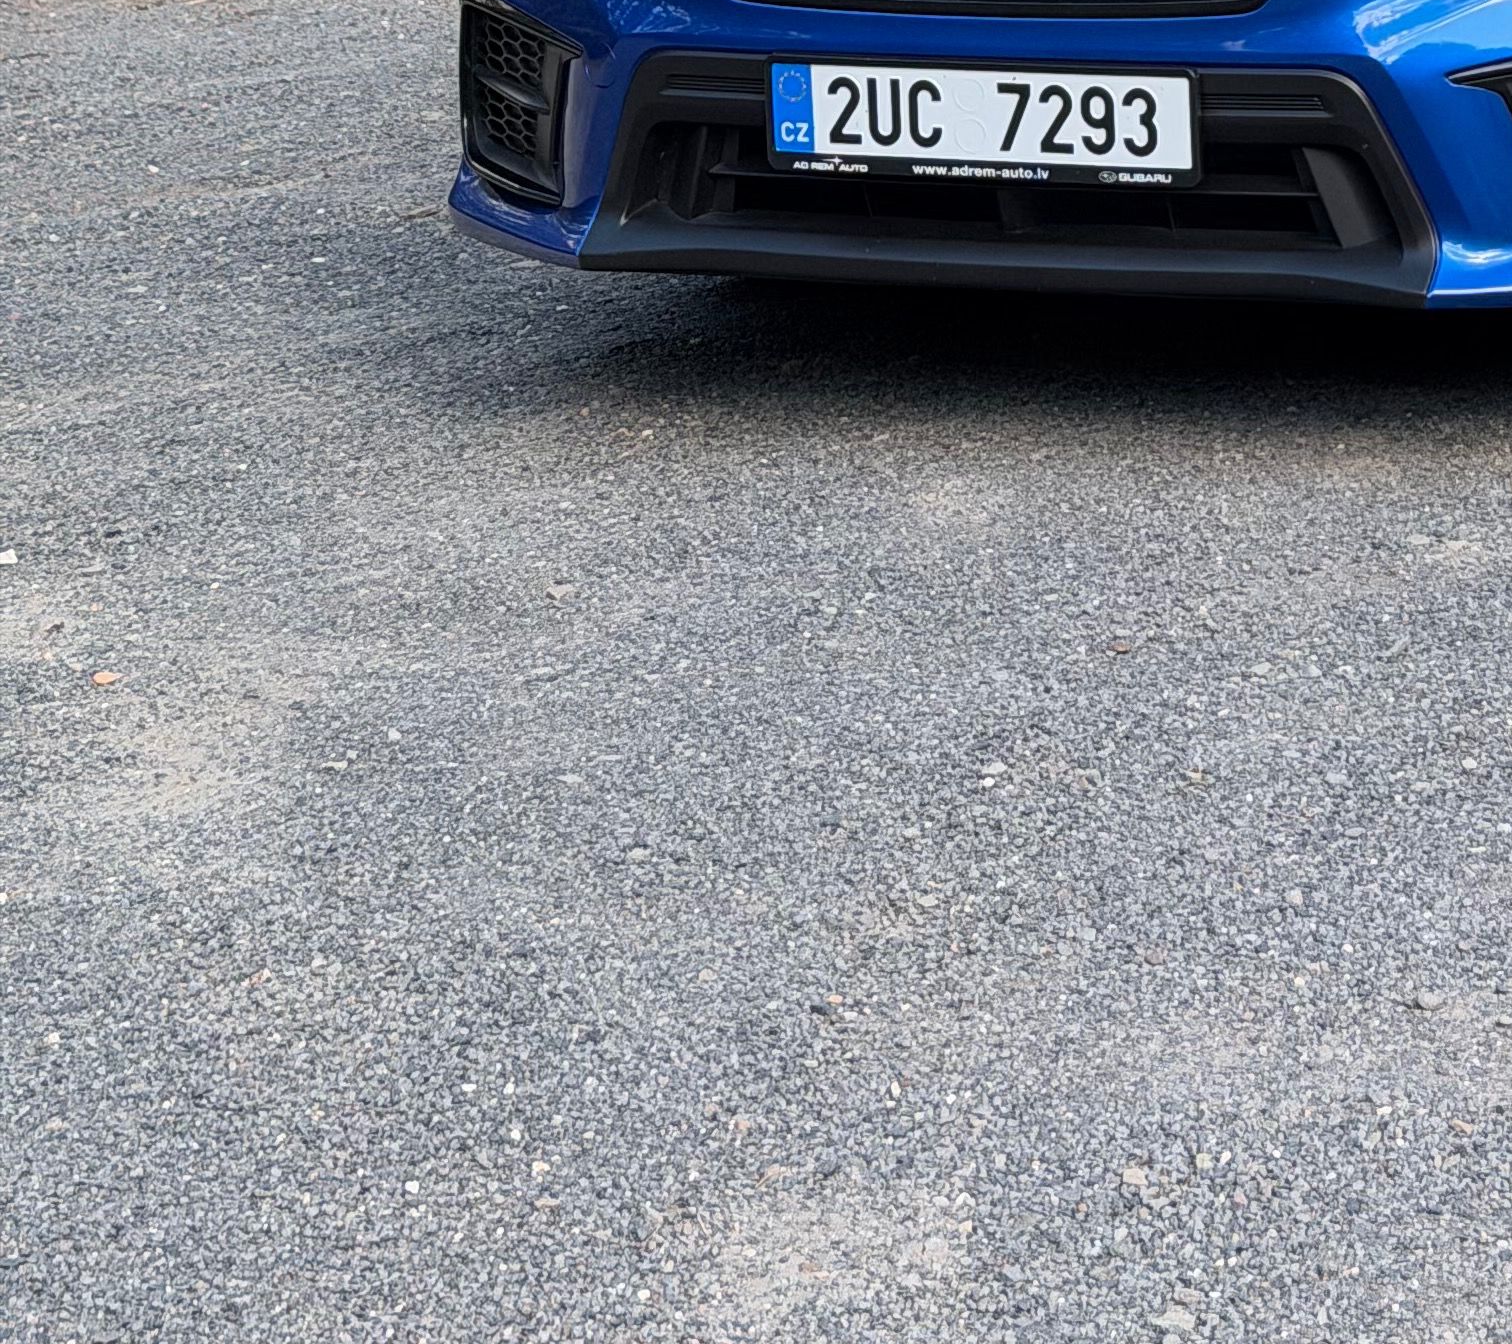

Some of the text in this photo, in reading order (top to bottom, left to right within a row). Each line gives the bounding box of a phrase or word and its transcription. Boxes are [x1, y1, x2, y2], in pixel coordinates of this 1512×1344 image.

[826, 76, 1159, 157] 2UC 7293
[780, 121, 810, 144] CZ
[838, 164, 870, 173] AUTO
[911, 164, 1049, 180] www.adrem-auto.lv
[1118, 173, 1173, 185] SUBARU
